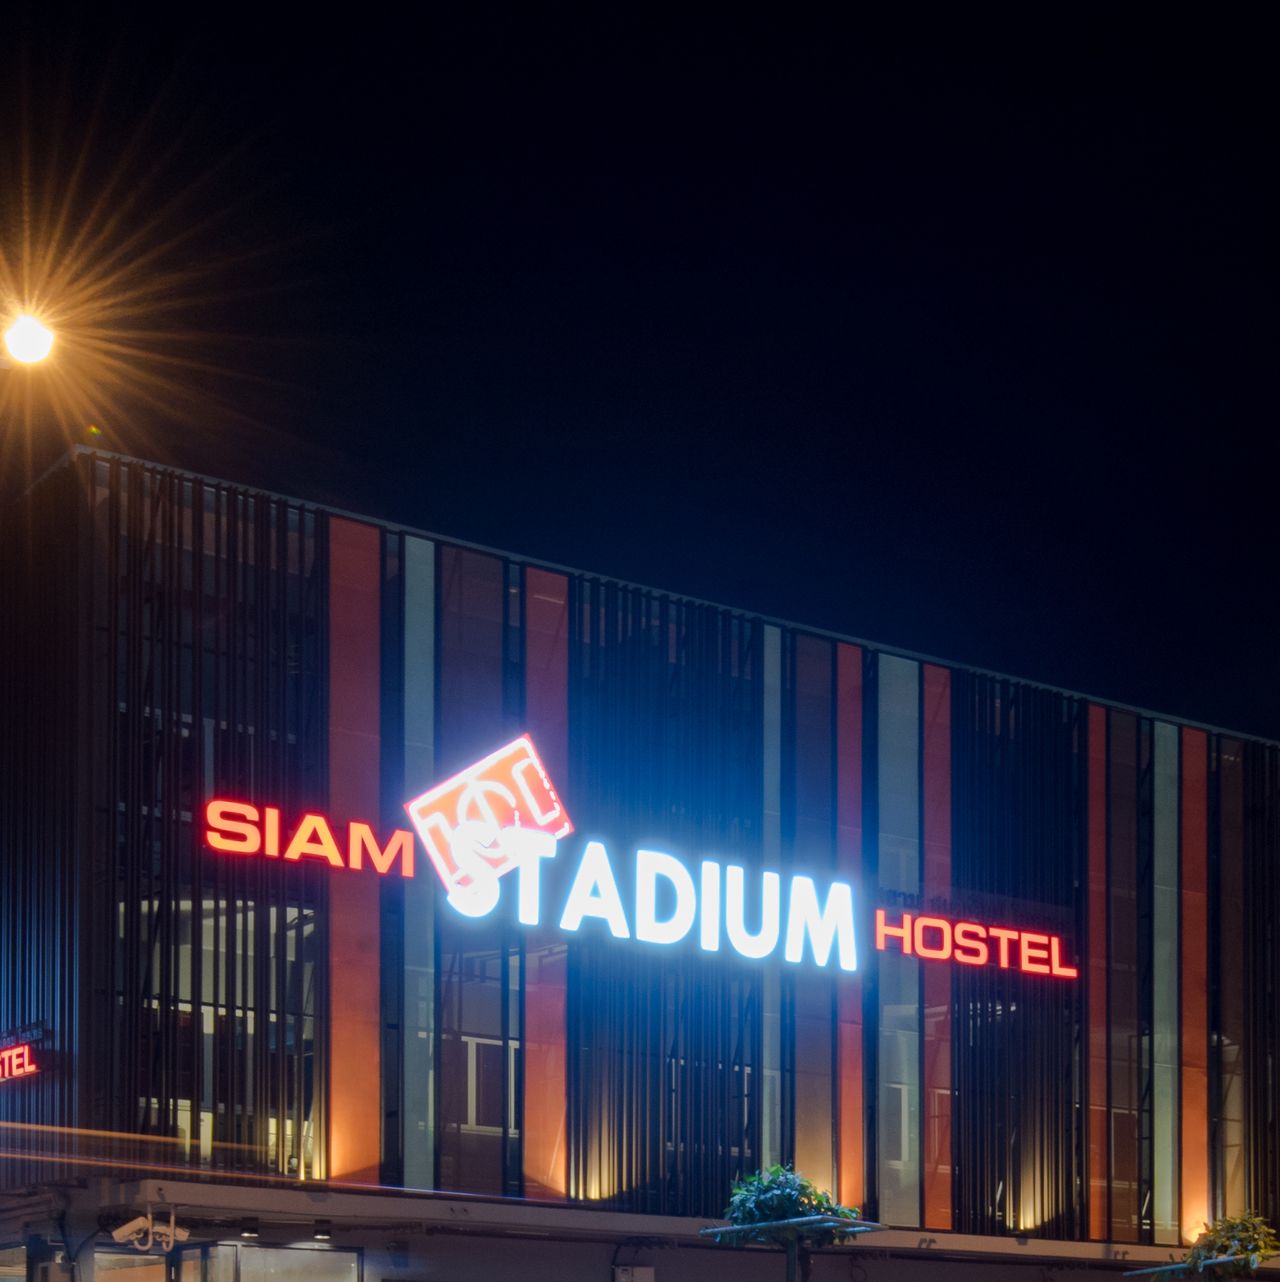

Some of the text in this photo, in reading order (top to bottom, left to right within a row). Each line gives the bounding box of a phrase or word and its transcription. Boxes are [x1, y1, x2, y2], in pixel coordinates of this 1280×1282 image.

[205, 800, 1078, 979] SIAM STADIUM HOSTEL
